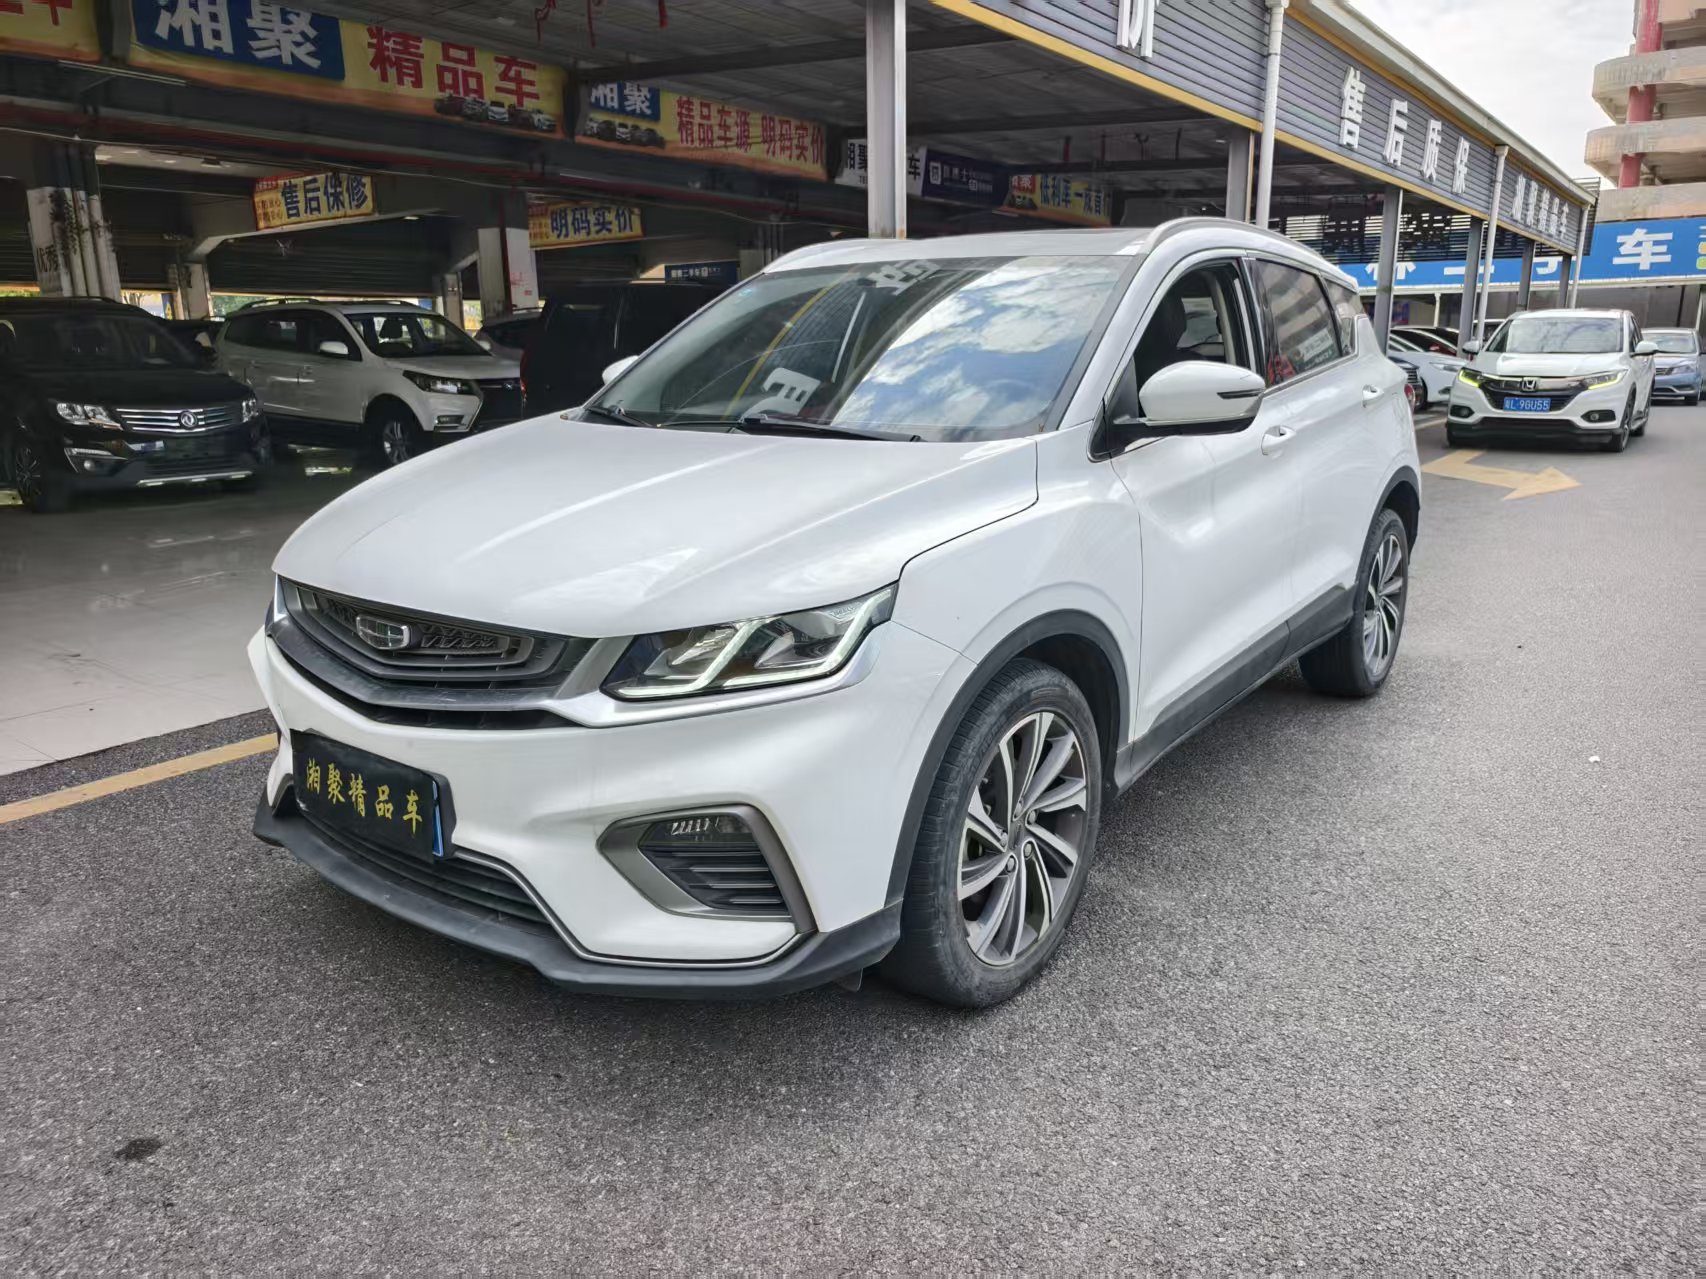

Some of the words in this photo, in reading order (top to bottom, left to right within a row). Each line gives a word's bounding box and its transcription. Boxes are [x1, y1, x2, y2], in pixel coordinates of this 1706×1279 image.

[367, 24, 541, 108] 精品车
[677, 95, 751, 152] 精品车源
[761, 114, 825, 165] 明码实价
[1339, 66, 1470, 195] 售后质保
[281, 171, 369, 219] 售后保修
[550, 206, 634, 239] 明码实价
[306, 757, 423, 837] 湘聚精品车
